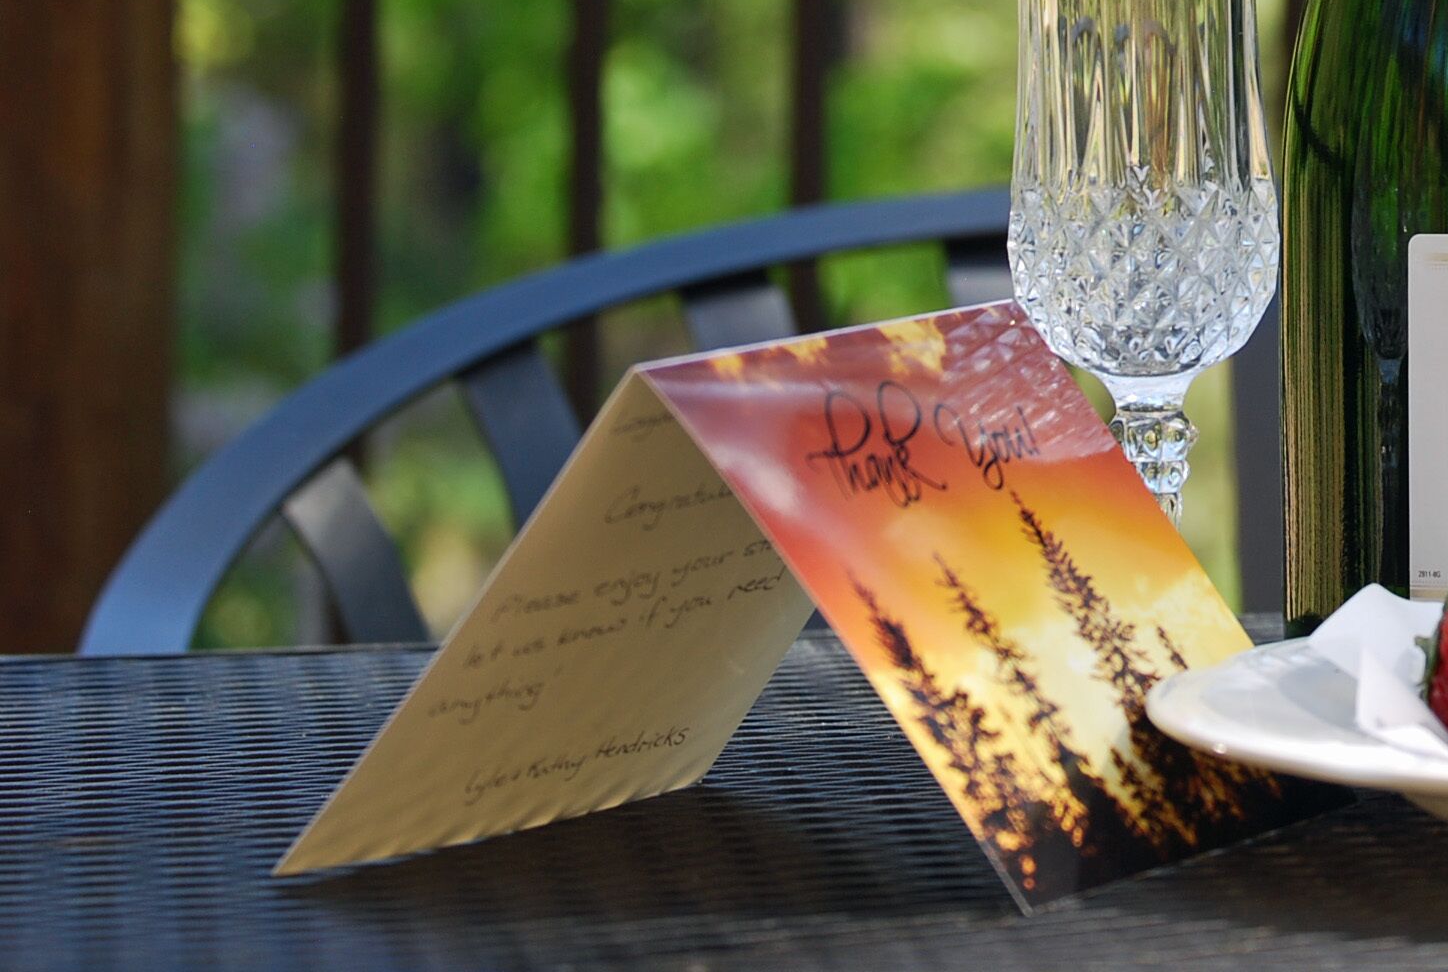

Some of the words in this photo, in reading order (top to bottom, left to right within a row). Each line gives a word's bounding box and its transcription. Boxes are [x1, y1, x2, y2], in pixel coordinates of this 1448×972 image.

[593, 568, 661, 606] enjoy
[671, 550, 734, 588] your
[638, 595, 667, 629] if
[664, 595, 712, 630] you
[727, 565, 786, 601] need
[594, 726, 691, 760] Hendricks
